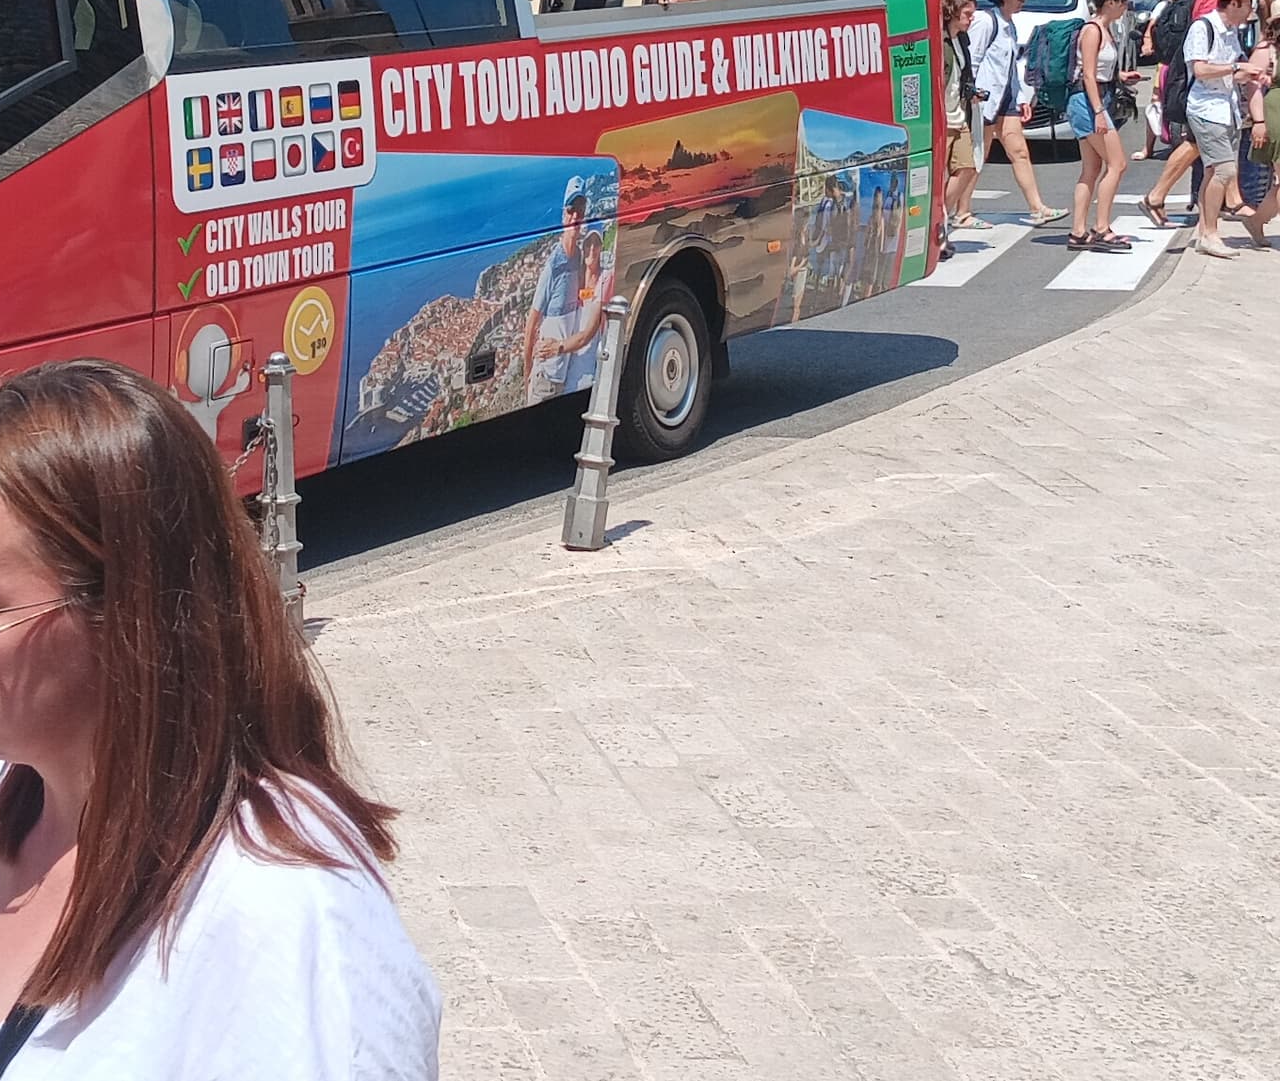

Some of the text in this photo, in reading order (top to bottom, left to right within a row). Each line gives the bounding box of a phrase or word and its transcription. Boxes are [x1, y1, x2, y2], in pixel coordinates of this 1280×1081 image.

[381, 23, 882, 137] CITY TOUR AUDIO GUIDE & WALKING TOUR
[206, 199, 346, 254] CITY WALLS TOUR
[206, 242, 334, 298] OLD TOWN TOUR
